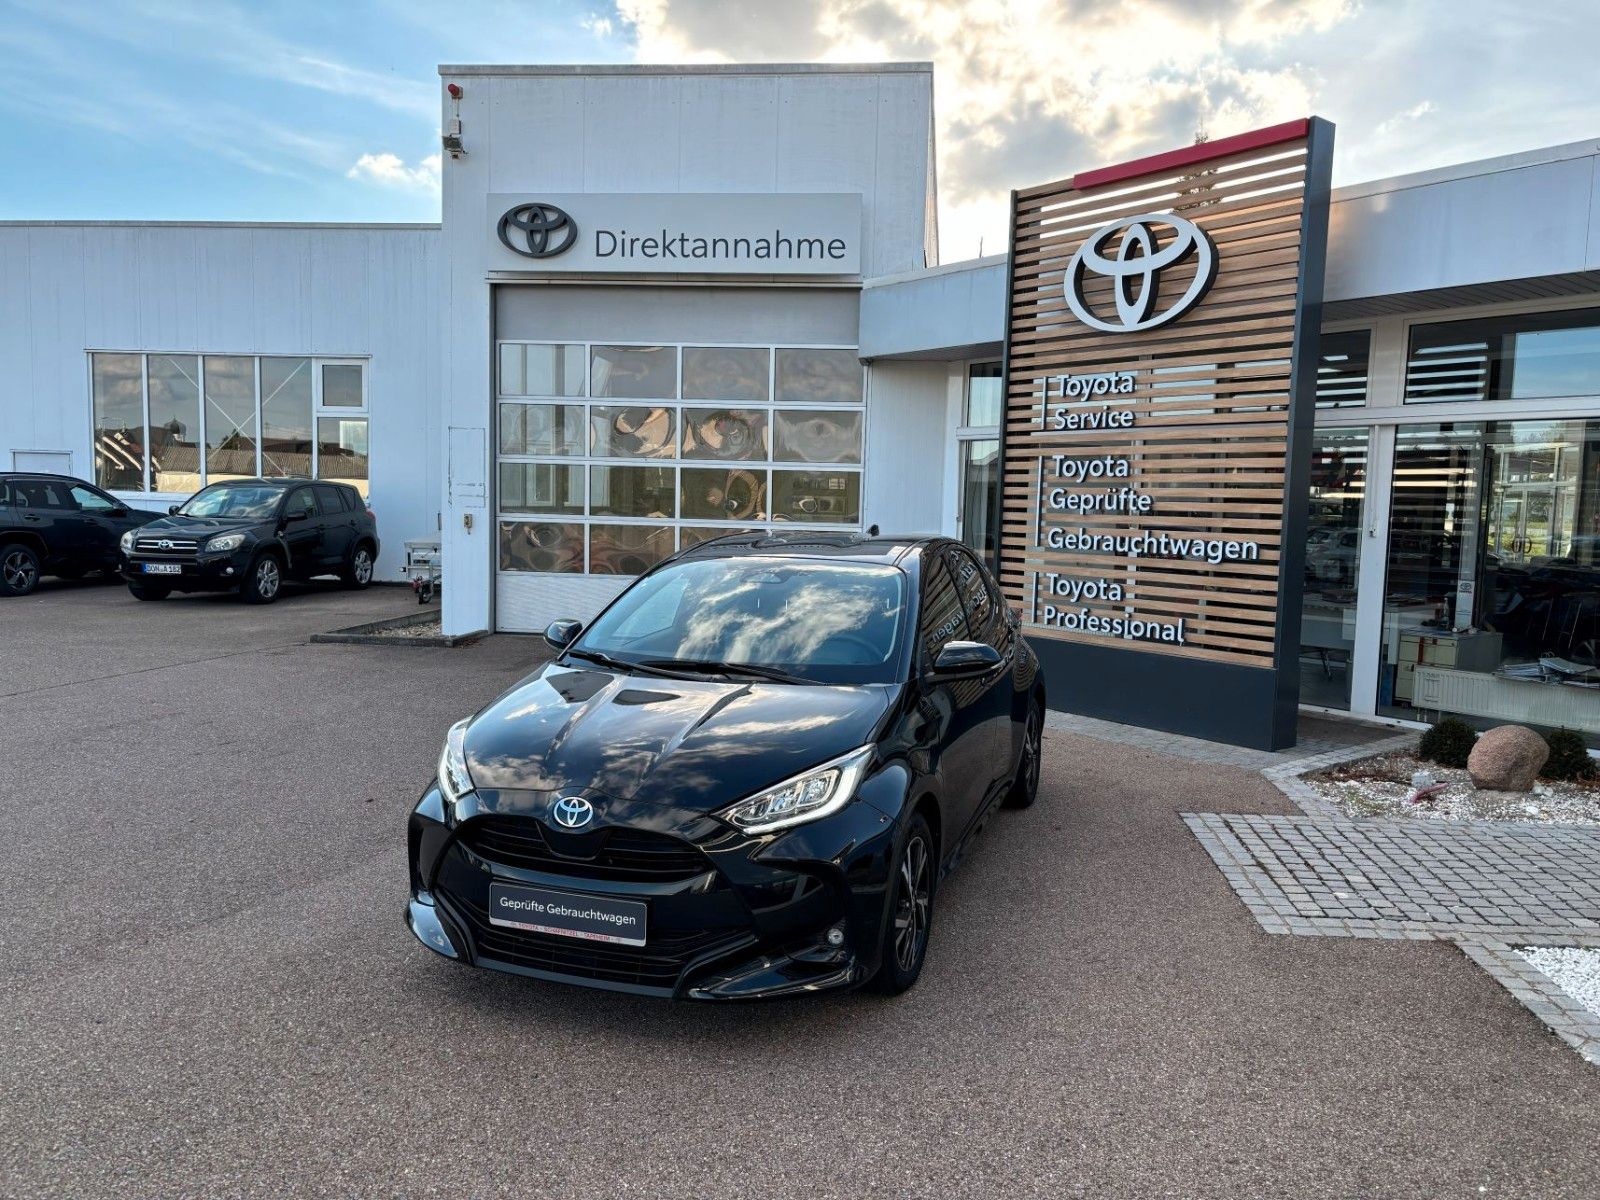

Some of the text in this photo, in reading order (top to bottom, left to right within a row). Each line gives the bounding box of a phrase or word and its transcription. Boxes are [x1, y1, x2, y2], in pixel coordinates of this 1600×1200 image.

[595, 229, 846, 259] Direktannahme
[1056, 374, 1135, 401] Toyota
[1054, 405, 1134, 430] Service
[1052, 454, 1130, 483] Toyota
[1049, 487, 1152, 515] Geprüfte
[1047, 527, 1259, 564] Gebrauchtwagen
[1046, 572, 1122, 602] Toyota
[1043, 605, 1184, 643] Professional
[499, 897, 636, 926] Geprüfte Gebrauchtwagen
